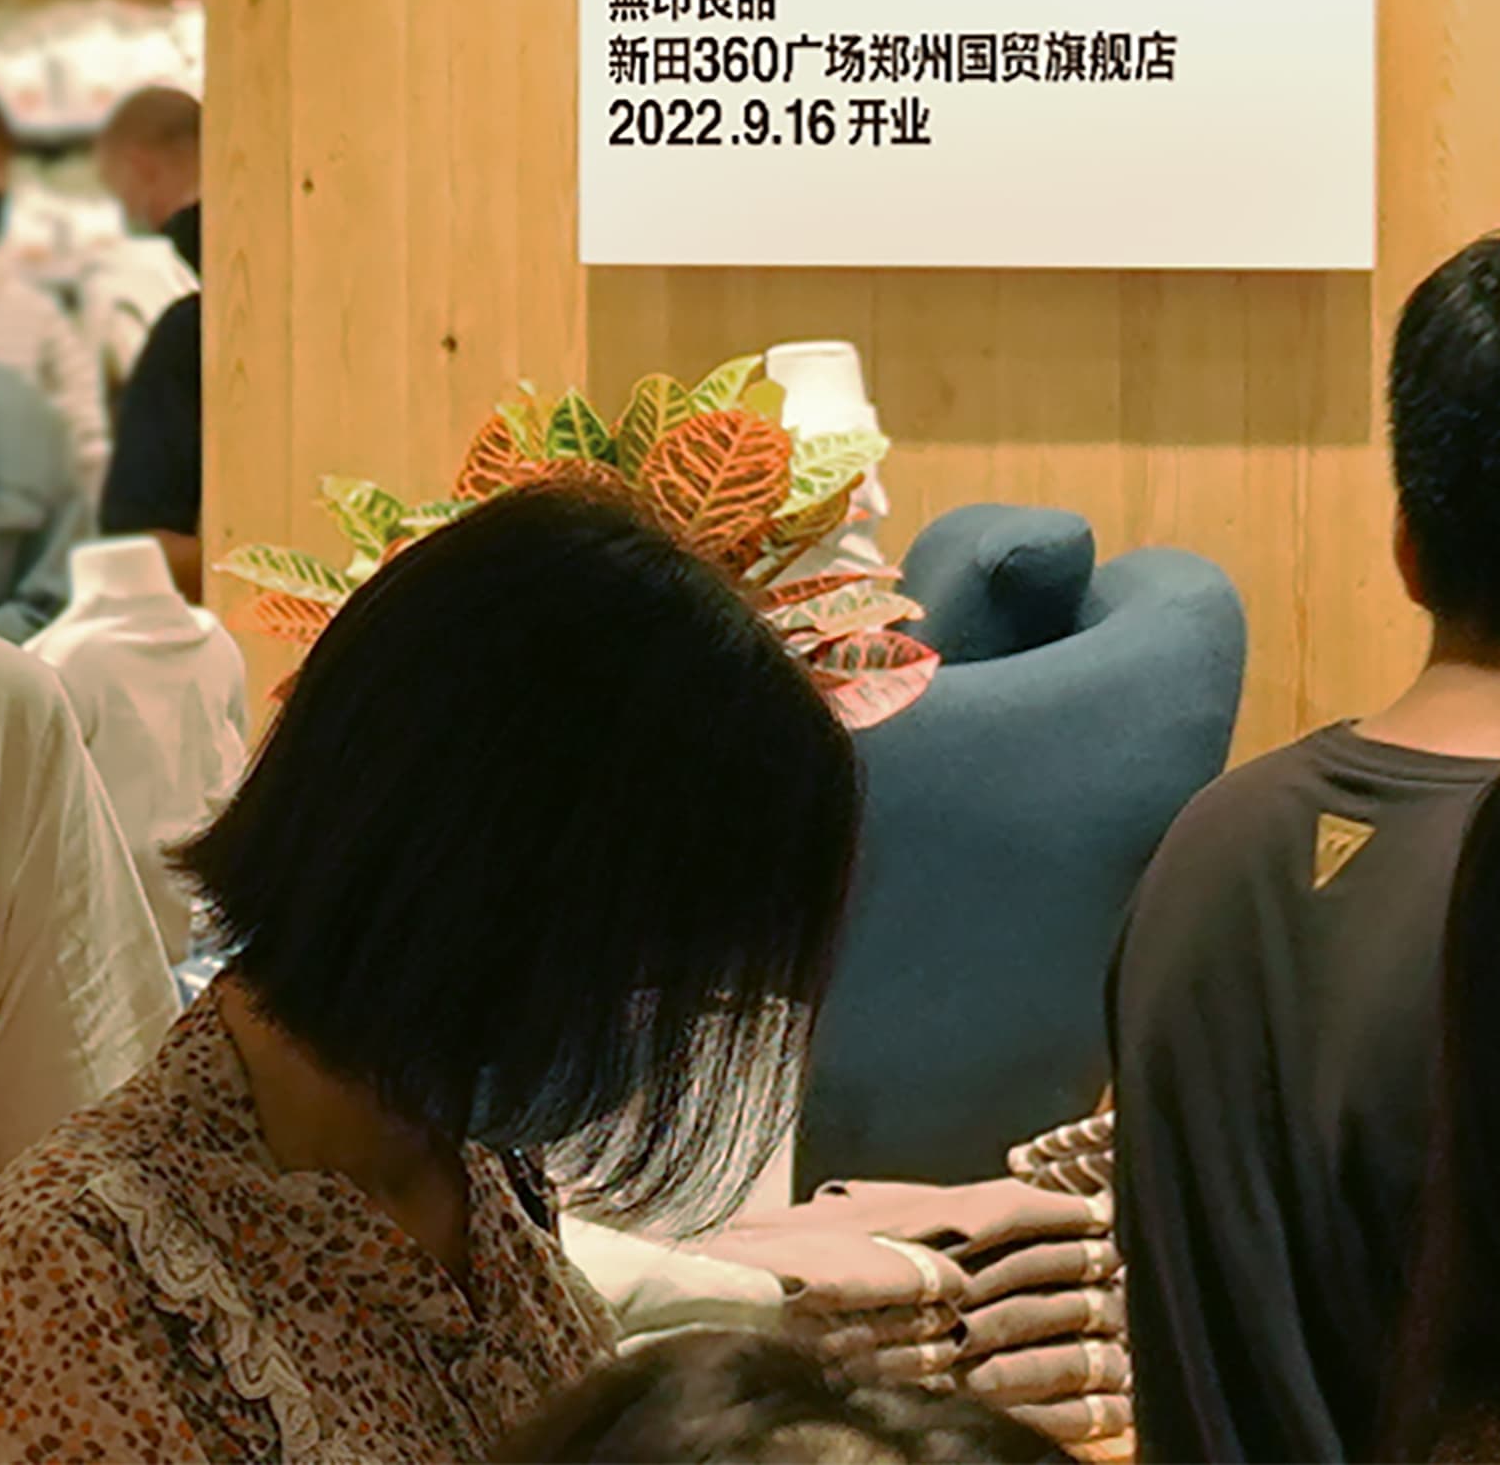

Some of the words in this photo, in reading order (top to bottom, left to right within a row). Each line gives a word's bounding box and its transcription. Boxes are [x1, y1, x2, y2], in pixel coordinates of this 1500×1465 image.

[608, 30, 1178, 85] 新田360广场郑州国贸旗舰店
[608, 98, 836, 146] 2022.9.16
[848, 96, 932, 147] 开业
